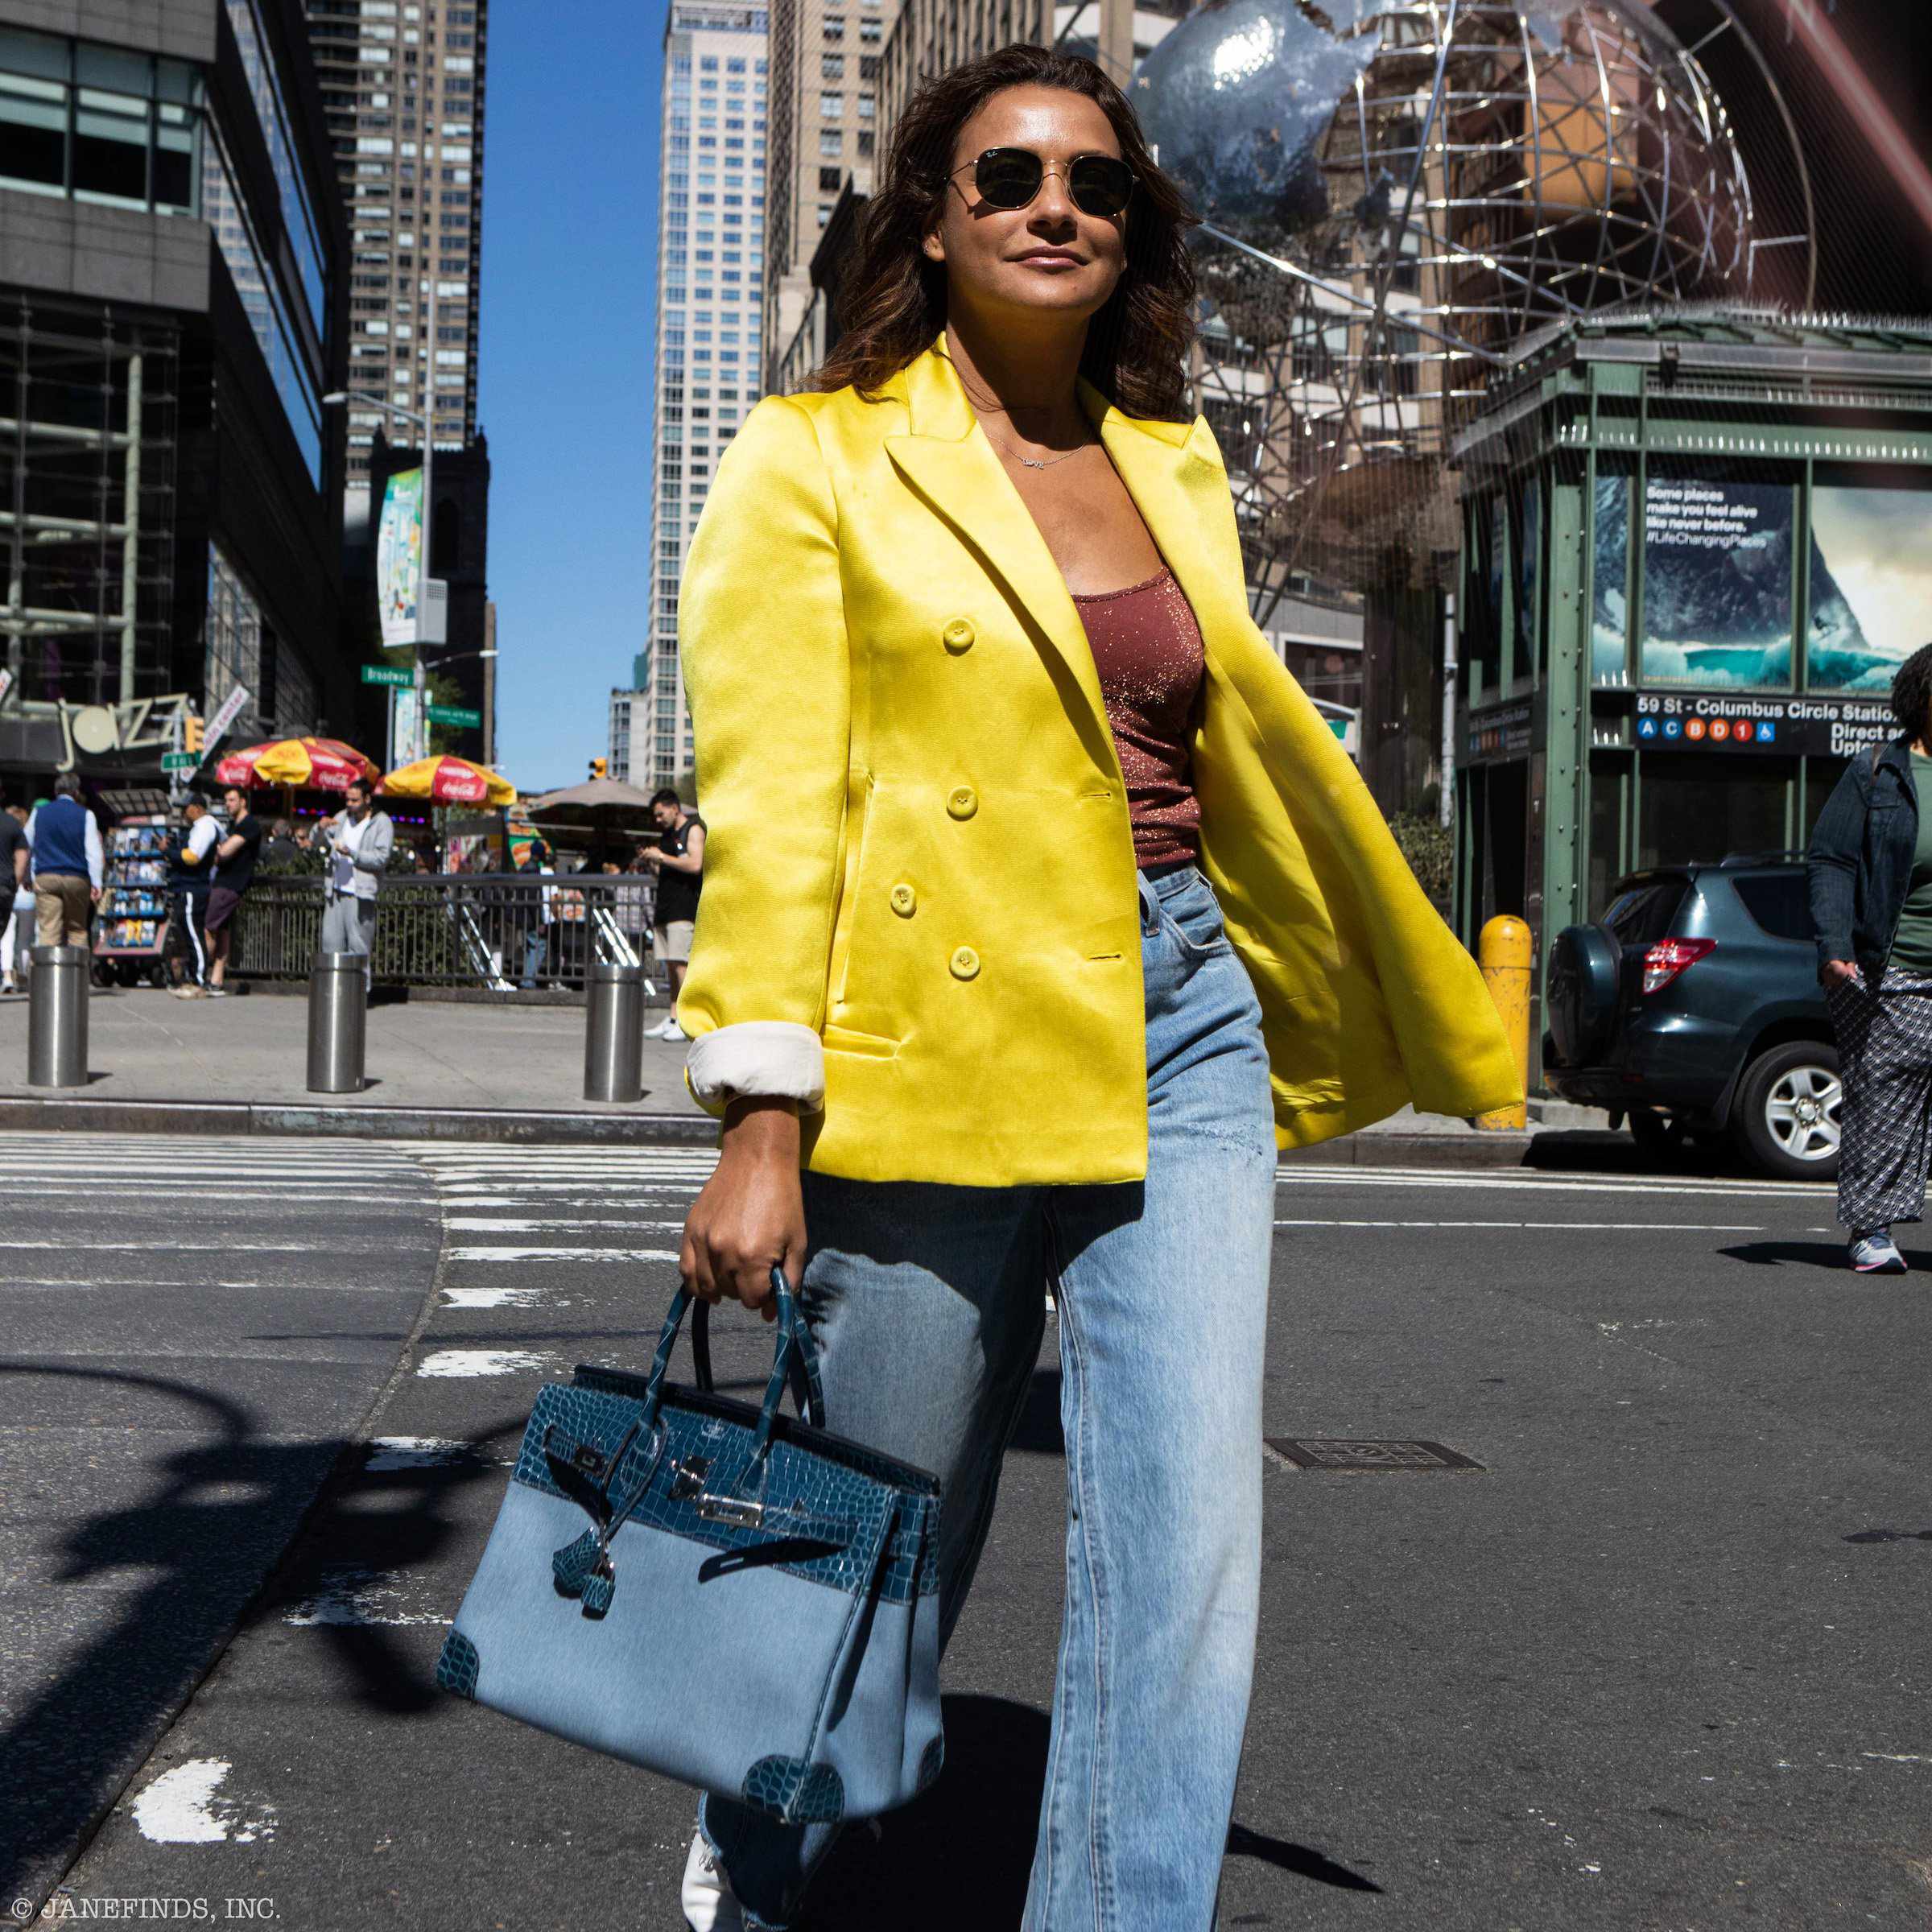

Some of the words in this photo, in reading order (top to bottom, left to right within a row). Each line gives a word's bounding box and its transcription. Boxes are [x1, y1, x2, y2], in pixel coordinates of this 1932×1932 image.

[1646, 485, 1682, 500] Some
[1683, 488, 1724, 502] places
[1646, 502, 1680, 514] make
[1681, 503, 1704, 517] you
[1705, 503, 1728, 517] feel
[1729, 504, 1758, 518] alive
[1646, 516, 1667, 529] like
[1668, 518, 1703, 530] never
[1703, 518, 1747, 533] before.
[1646, 530, 1767, 550] #LifeChangingPlaces
[367, 667, 409, 686] Broadway
[1637, 696, 1660, 713] 59
[1664, 697, 1683, 714] St
[1695, 698, 1785, 718] Columbus
[1787, 702, 1839, 720] Circle
[1842, 704, 1898, 723] Statio
[1831, 723, 1884, 741] Direct
